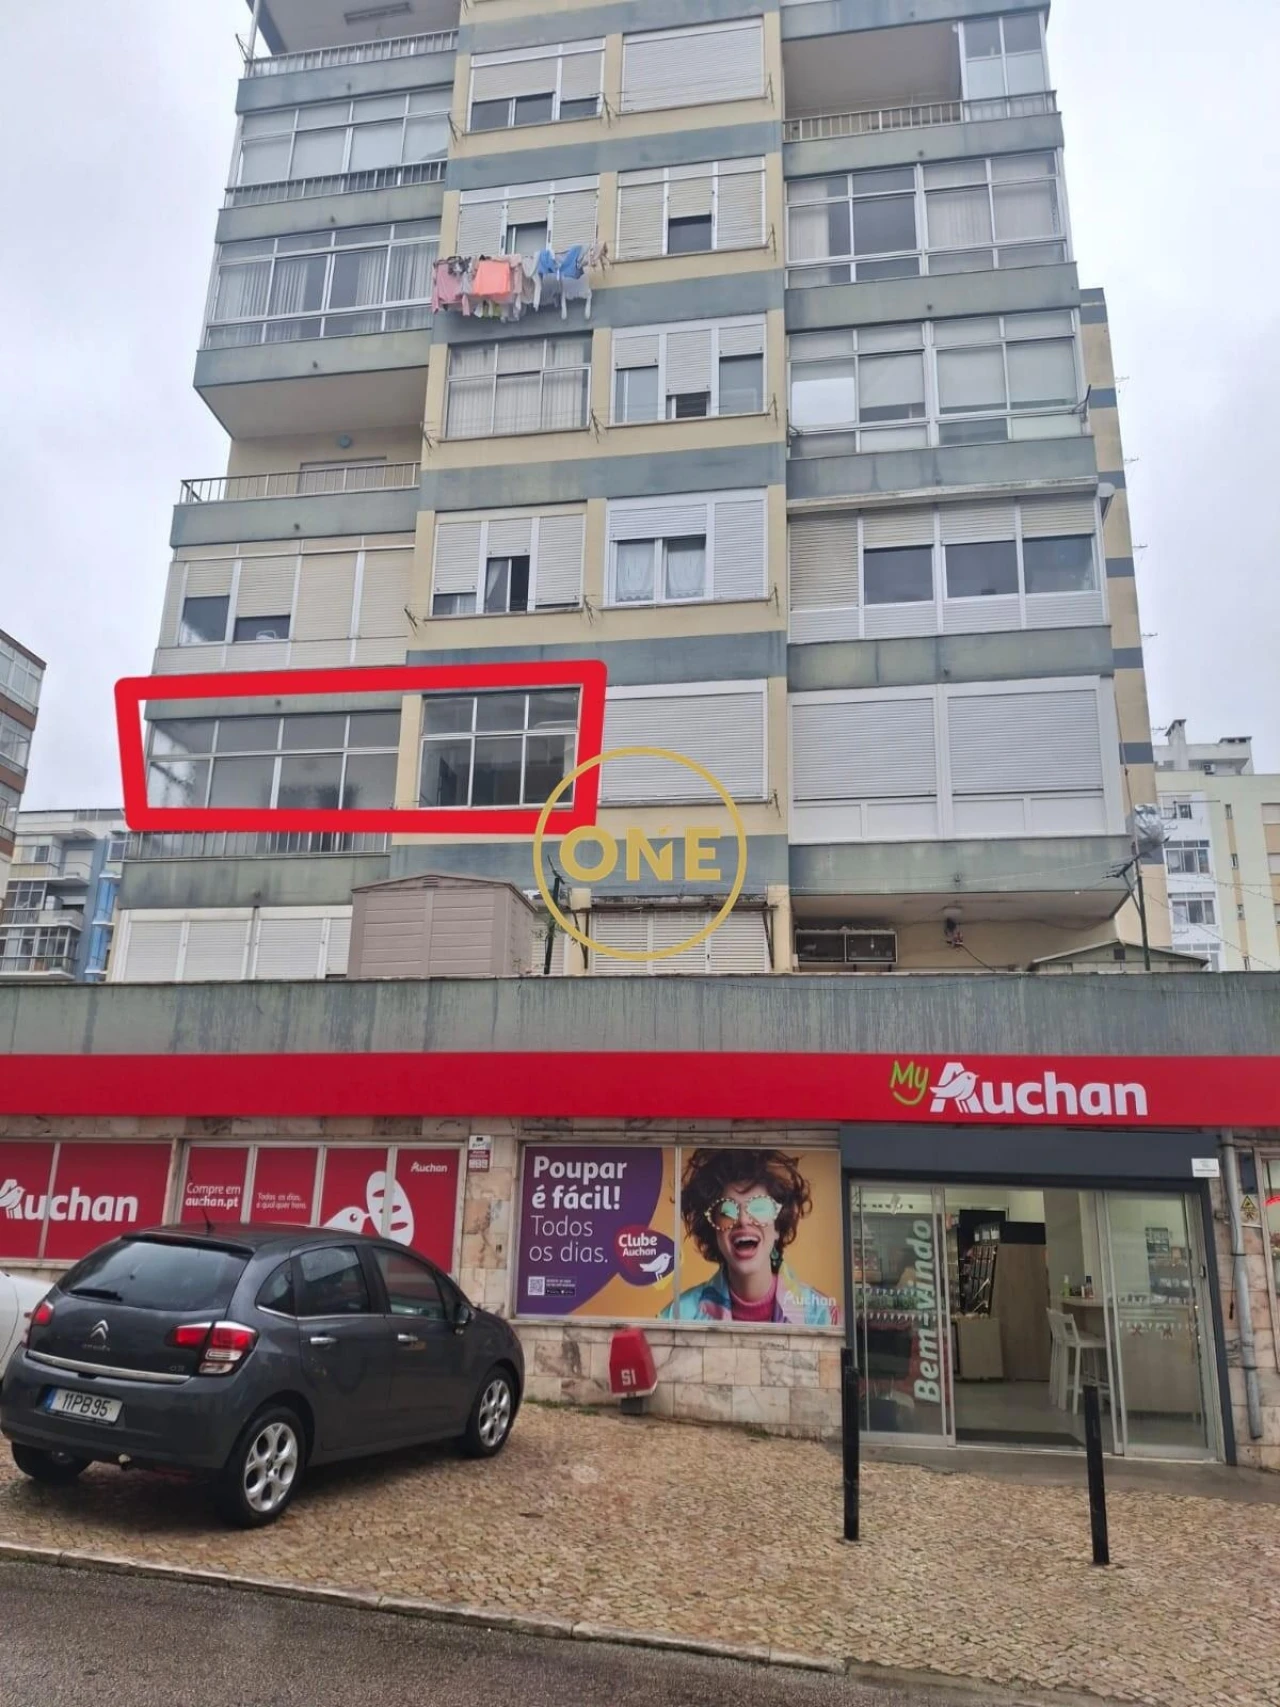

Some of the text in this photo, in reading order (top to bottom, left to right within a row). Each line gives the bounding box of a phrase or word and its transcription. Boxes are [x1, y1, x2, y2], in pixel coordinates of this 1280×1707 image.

[890, 1060, 1148, 1116] My Auchan
[410, 1161, 448, 1173] Auchan
[533, 1155, 628, 1185] Poupar
[0, 1178, 139, 1222] Auchan
[186, 1182, 241, 1197] Compre em
[531, 1184, 621, 1210] é fácil!
[185, 1195, 239, 1210] auchan.pt
[530, 1215, 594, 1237] Todos
[618, 1232, 658, 1248] Clube
[529, 1240, 608, 1263] os dias.
[622, 1246, 657, 1257] Auchan
[783, 1290, 837, 1307] Auchan
[906, 1219, 941, 1404] Bem-vindo
